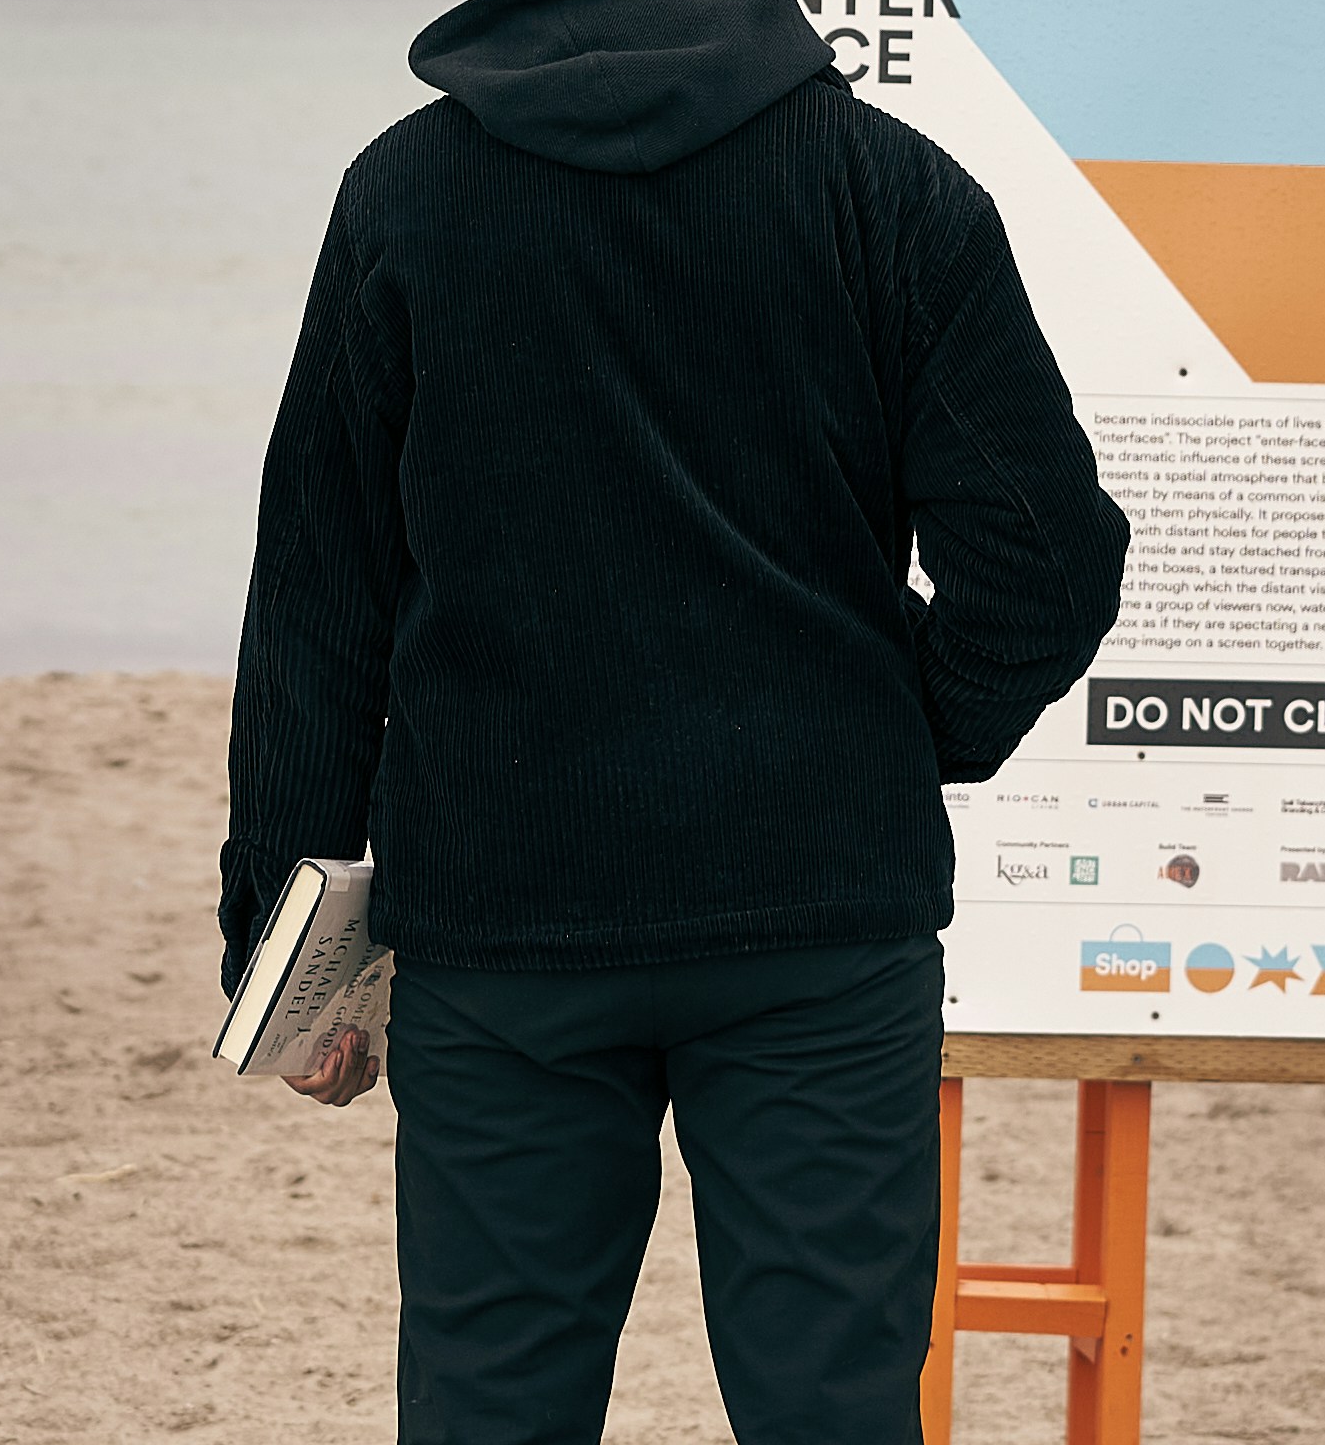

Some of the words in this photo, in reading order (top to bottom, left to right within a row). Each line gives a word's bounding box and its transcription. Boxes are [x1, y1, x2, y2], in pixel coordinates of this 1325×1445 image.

[824, 27, 913, 84] CE
[1094, 412, 1147, 425] became
[1151, 413, 1235, 427] indissociable
[1239, 418, 1272, 429] parts
[1293, 416, 1322, 429] lives
[1177, 432, 1201, 445] The
[1205, 433, 1251, 448] project
[1098, 449, 1114, 461] he
[1118, 450, 1176, 463] dramatic
[1180, 451, 1240, 464] influence
[1261, 453, 1297, 465] these
[1101, 470, 1149, 481] resents
[1165, 470, 1207, 484] spatial
[1211, 471, 1288, 485] atmosphere
[1292, 472, 1318, 484] that
[1109, 487, 1149, 499] ether
[1153, 487, 1169, 502] by
[1173, 491, 1215, 501] means
[1247, 492, 1305, 503] common
[1150, 506, 1184, 518] them
[1134, 524, 1162, 536] with
[1165, 524, 1210, 537] distant
[1213, 525, 1247, 538] holes
[1251, 526, 1269, 539] for
[1273, 527, 1318, 541] people
[1139, 542, 1177, 556] inside
[1181, 544, 1205, 556] and
[1209, 546, 1236, 559] stay
[1239, 545, 1301, 557] detached
[1138, 561, 1160, 573] the
[1221, 563, 1276, 577] textured
[1138, 579, 1190, 594] through
[1193, 580, 1232, 593] which
[1236, 581, 1258, 594] the
[1261, 581, 1306, 594] distant
[1156, 601, 1194, 612] group
[1213, 599, 1262, 612] viewers
[1173, 617, 1201, 631] they
[1205, 621, 1225, 629] are
[1229, 619, 1298, 632] spectating
[1104, 634, 1182, 648] oving-image
[1185, 639, 1202, 647] on
[1217, 639, 1261, 648] screen
[1105, 695, 1168, 731] DO
[1181, 697, 1272, 732] NOT
[996, 840, 1037, 849] Community
[1280, 845, 1316, 853] Presented
[306, 919, 360, 1016] MICHAEL
[1094, 952, 1157, 981] Shop
[285, 936, 333, 1020] SANDEL
